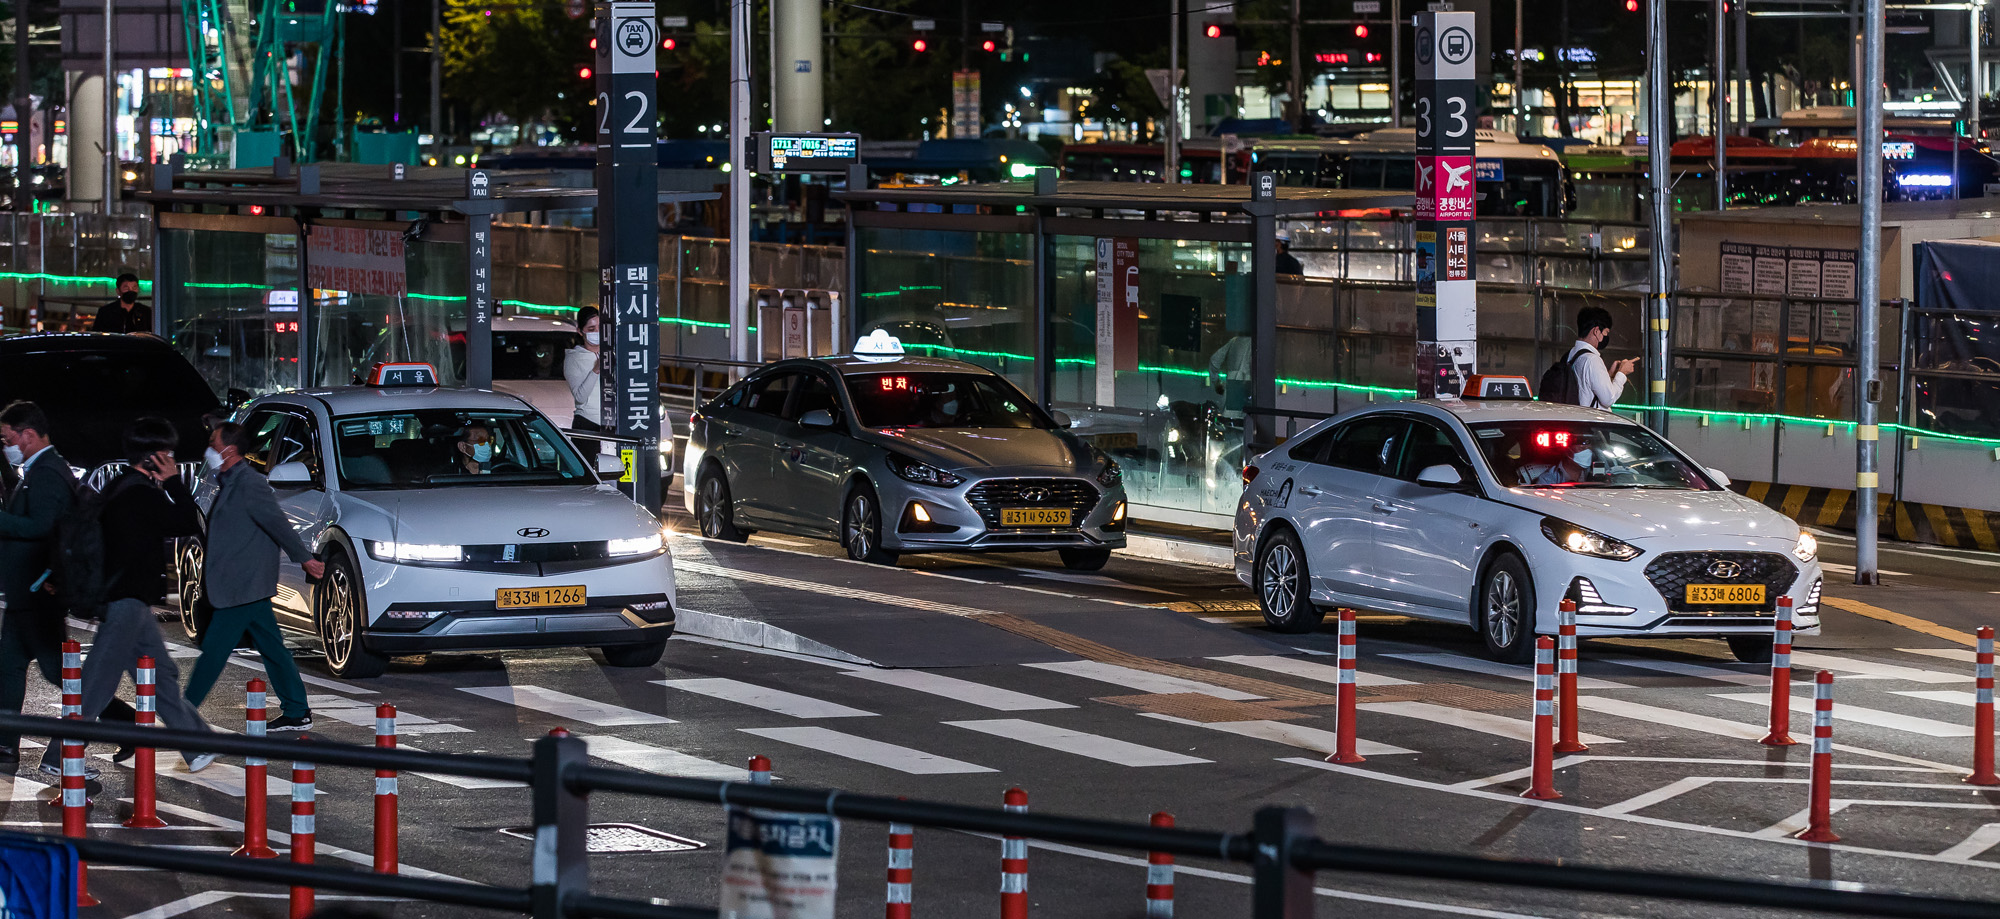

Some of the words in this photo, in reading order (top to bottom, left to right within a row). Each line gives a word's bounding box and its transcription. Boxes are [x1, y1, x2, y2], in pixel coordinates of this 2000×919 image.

[625, 25, 644, 33] TAXI
[599, 92, 610, 134] 2
[624, 91, 649, 133] 2
[1418, 97, 1431, 137] 3
[1445, 97, 1468, 137] 3
[773, 140, 792, 149] 1711
[801, 140, 820, 149] 7016
[473, 188, 487, 196] TAXI
[1439, 197, 1472, 211] 공항버스
[1448, 232, 1466, 242] 서울
[475, 231, 486, 258] 택시
[1448, 244, 1467, 255] 시티
[1448, 257, 1466, 268] 버스
[1448, 270, 1466, 278] 정류장
[476, 268, 487, 323] 내리는곳
[275, 322, 298, 333] 빈차
[874, 341, 900, 350] 서울
[1439, 345, 1447, 357] 3
[393, 370, 425, 383] 서울
[881, 377, 908, 390] 빈차
[1494, 384, 1521, 396] 서울
[1537, 432, 1569, 447] 예약
[1038, 511, 1067, 523] 9639
[544, 588, 580, 604] 1266
[1728, 587, 1760, 602] 6806
